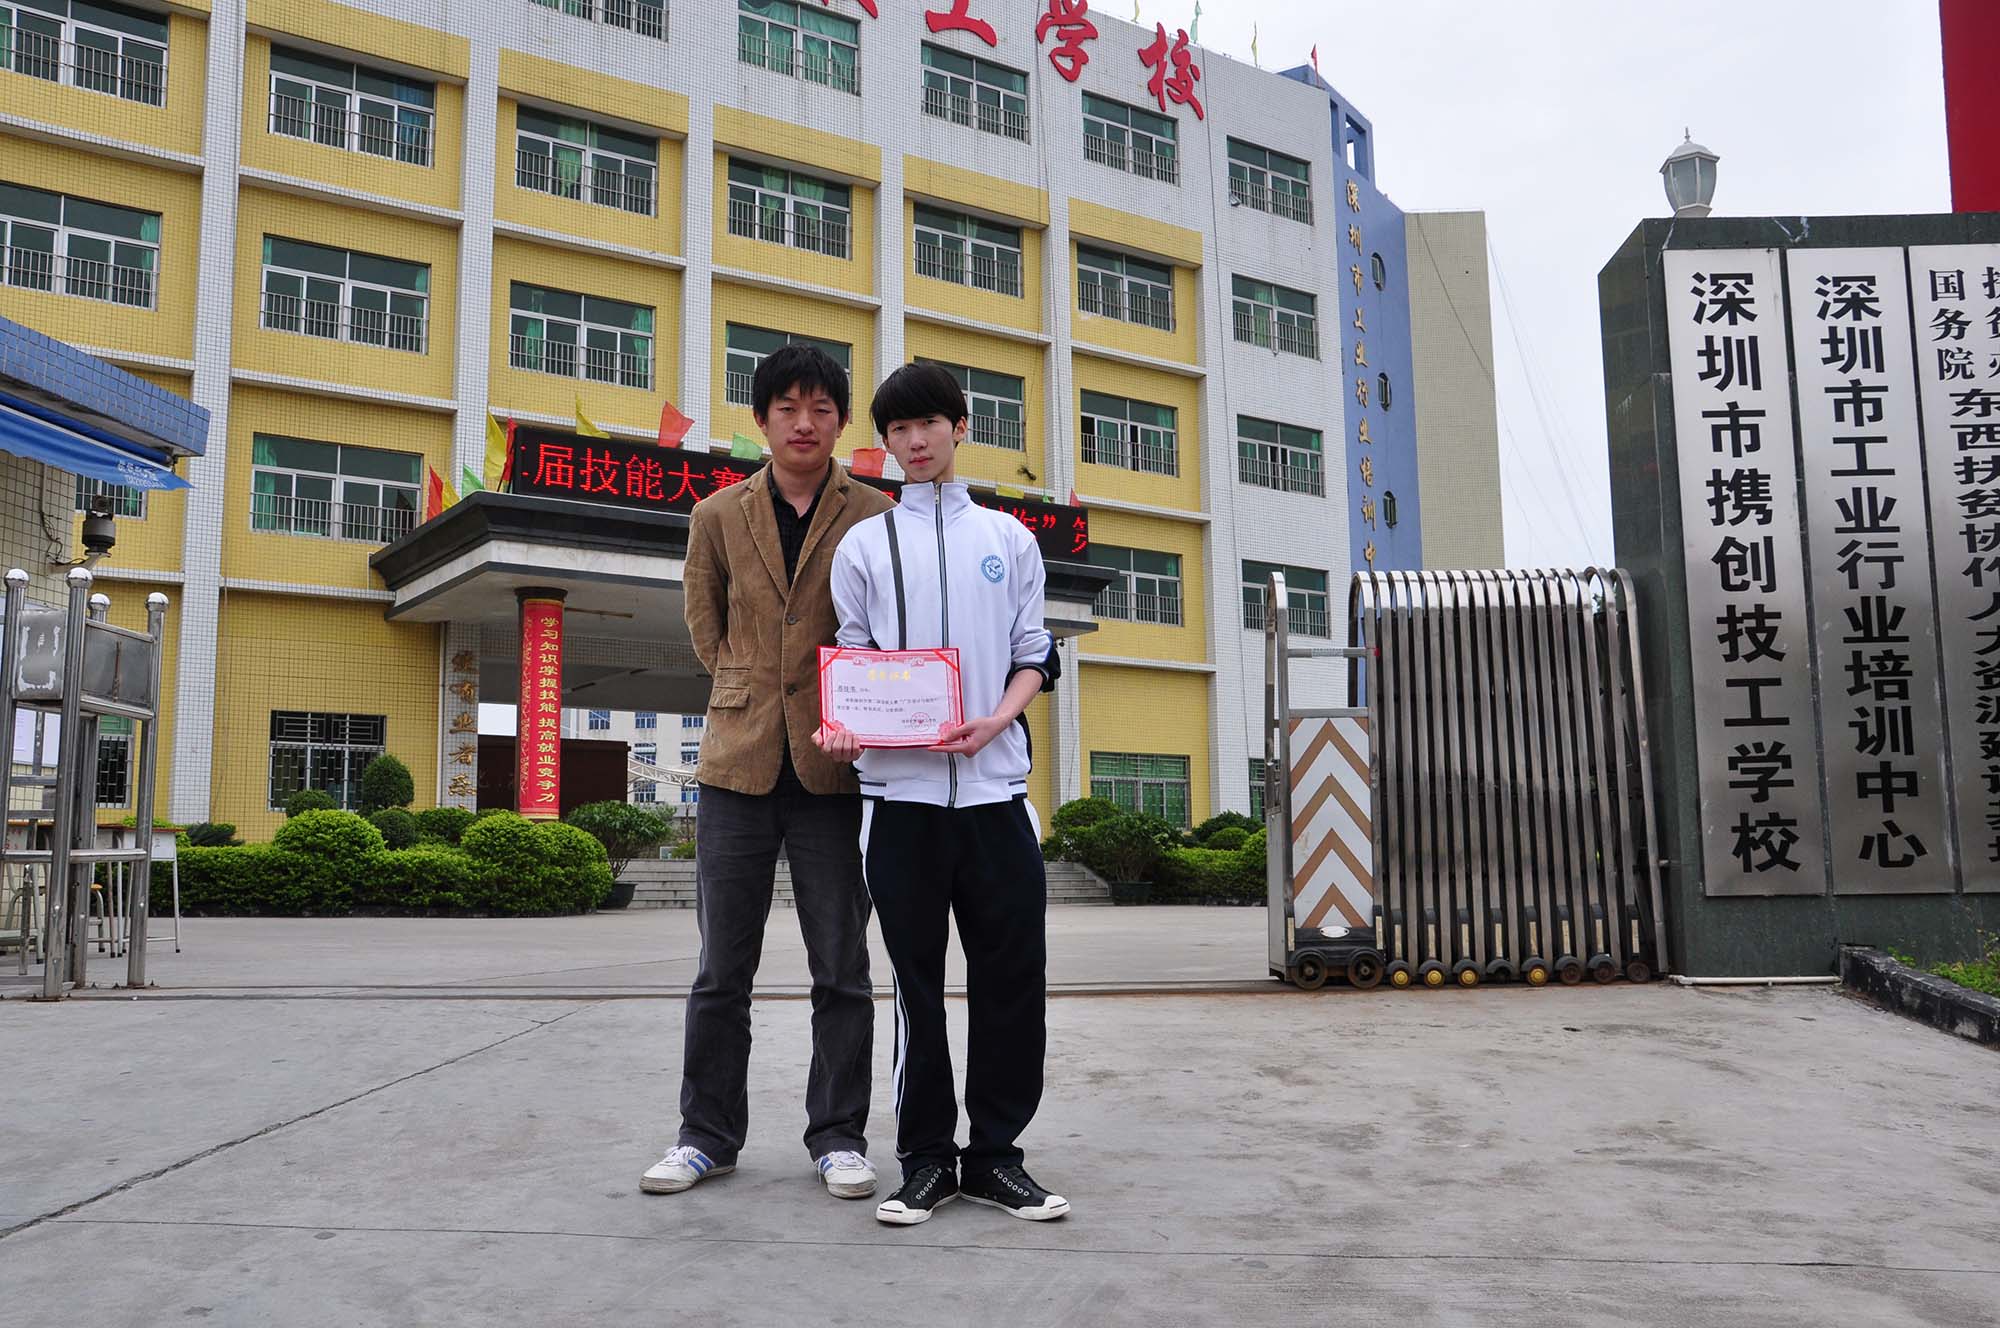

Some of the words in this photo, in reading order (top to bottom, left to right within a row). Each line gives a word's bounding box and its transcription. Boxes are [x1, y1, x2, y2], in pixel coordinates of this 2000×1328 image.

[521, 442, 746, 503] 届技能大赛
[1929, 268, 1975, 381] 国务院
[1690, 271, 1802, 873] 深圳市携创技工学校
[1814, 274, 1928, 869] 深圳市工业行业培训中心
